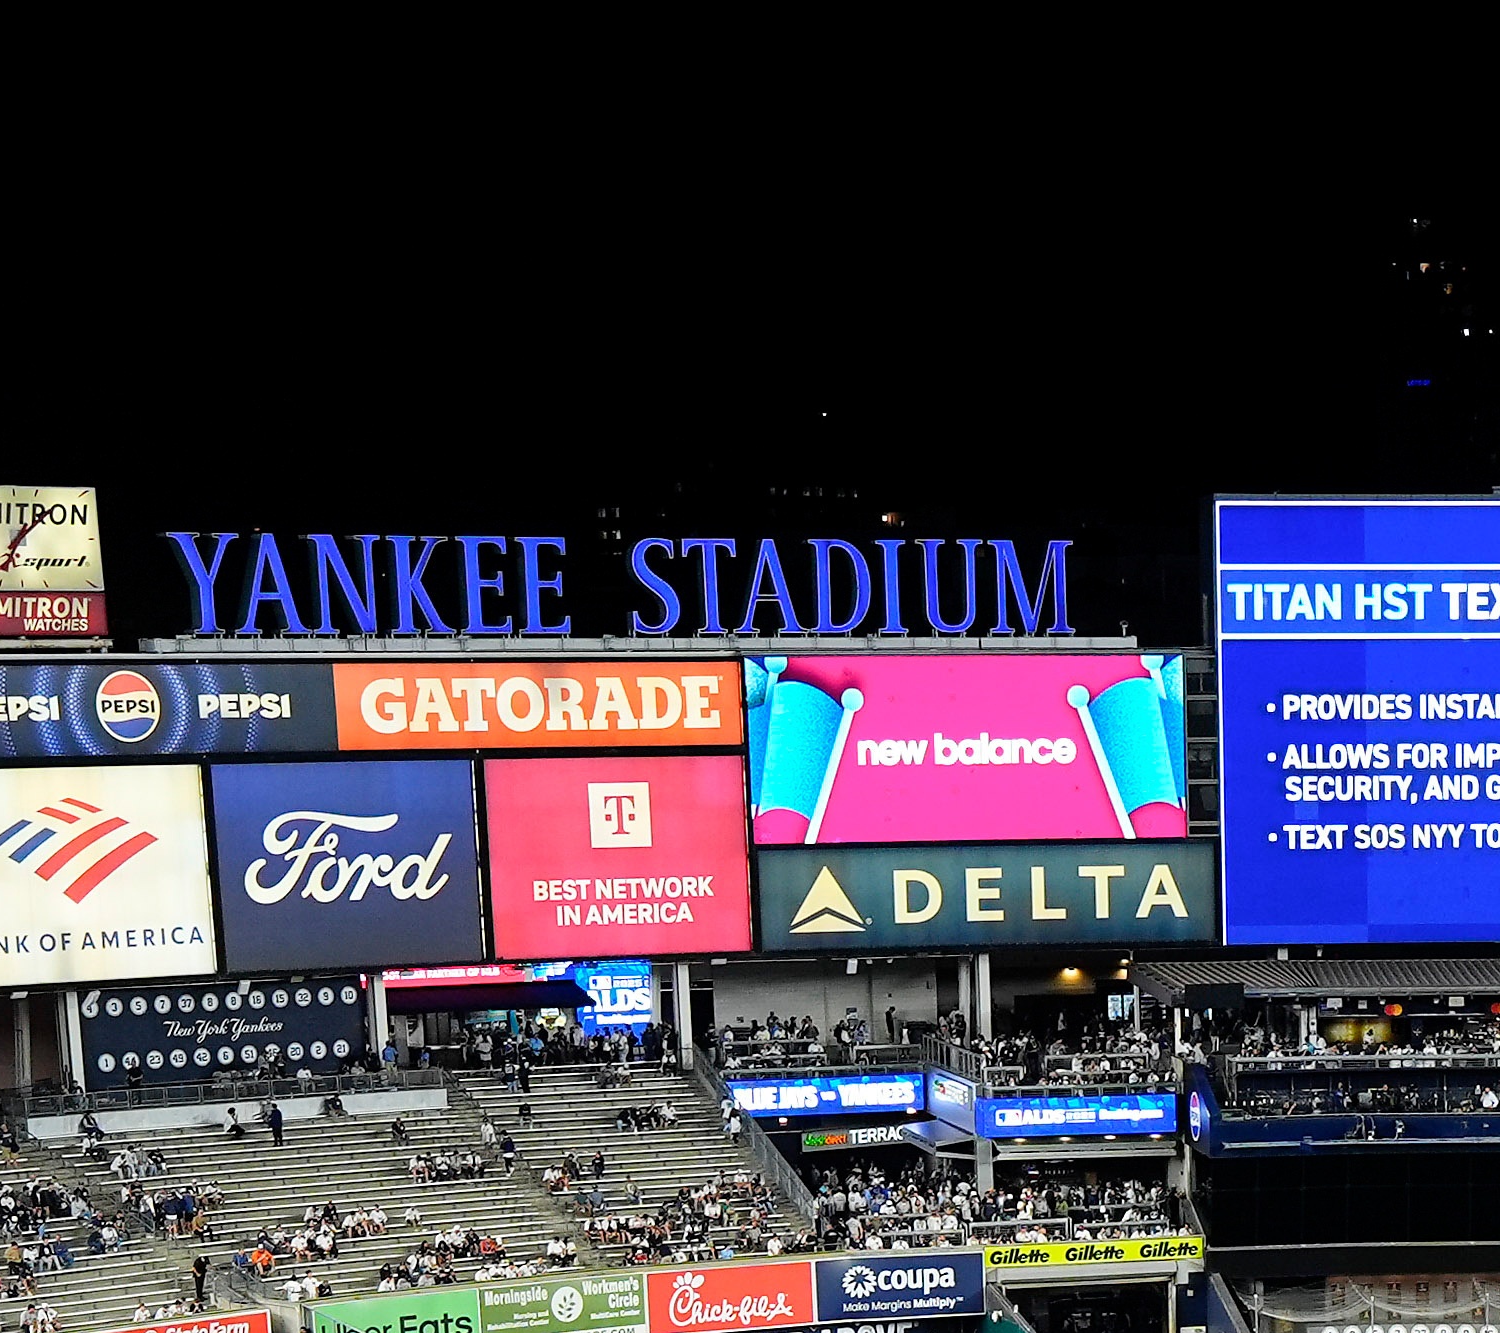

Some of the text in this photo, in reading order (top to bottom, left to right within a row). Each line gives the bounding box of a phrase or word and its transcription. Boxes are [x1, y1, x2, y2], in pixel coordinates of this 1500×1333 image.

[166, 531, 1076, 635] YANKEE STADIUM
[1227, 584, 1341, 620] TITAN
[1355, 584, 1432, 620] HST
[24, 618, 88, 631] WATCHES
[100, 699, 156, 715] PEPSI
[198, 694, 291, 719] PEPSI
[359, 675, 723, 734] GATORADE
[1283, 694, 1412, 720] PROVIDES
[857, 733, 1077, 766] new balance
[1283, 745, 1389, 770] ALLOWS
[1397, 744, 1446, 769] FOR
[1284, 776, 1417, 804] SECURITY,
[1424, 776, 1479, 801] AND
[1283, 826, 1347, 849] TEXT
[1354, 826, 1405, 849] SOS
[1412, 825, 1463, 848] NYY
[244, 811, 453, 904] Ford
[533, 875, 714, 901] BEST NETWORK
[893, 864, 1188, 924] DELTA
[557, 902, 693, 926] IN AMERICA
[39, 932, 72, 952] OF
[82, 926, 204, 950] AMERICA
[163, 1016, 283, 1043] New York Yankees
[990, 1242, 1198, 1265] Gillette Gillette Gillette
[878, 1266, 955, 1291] coupa
